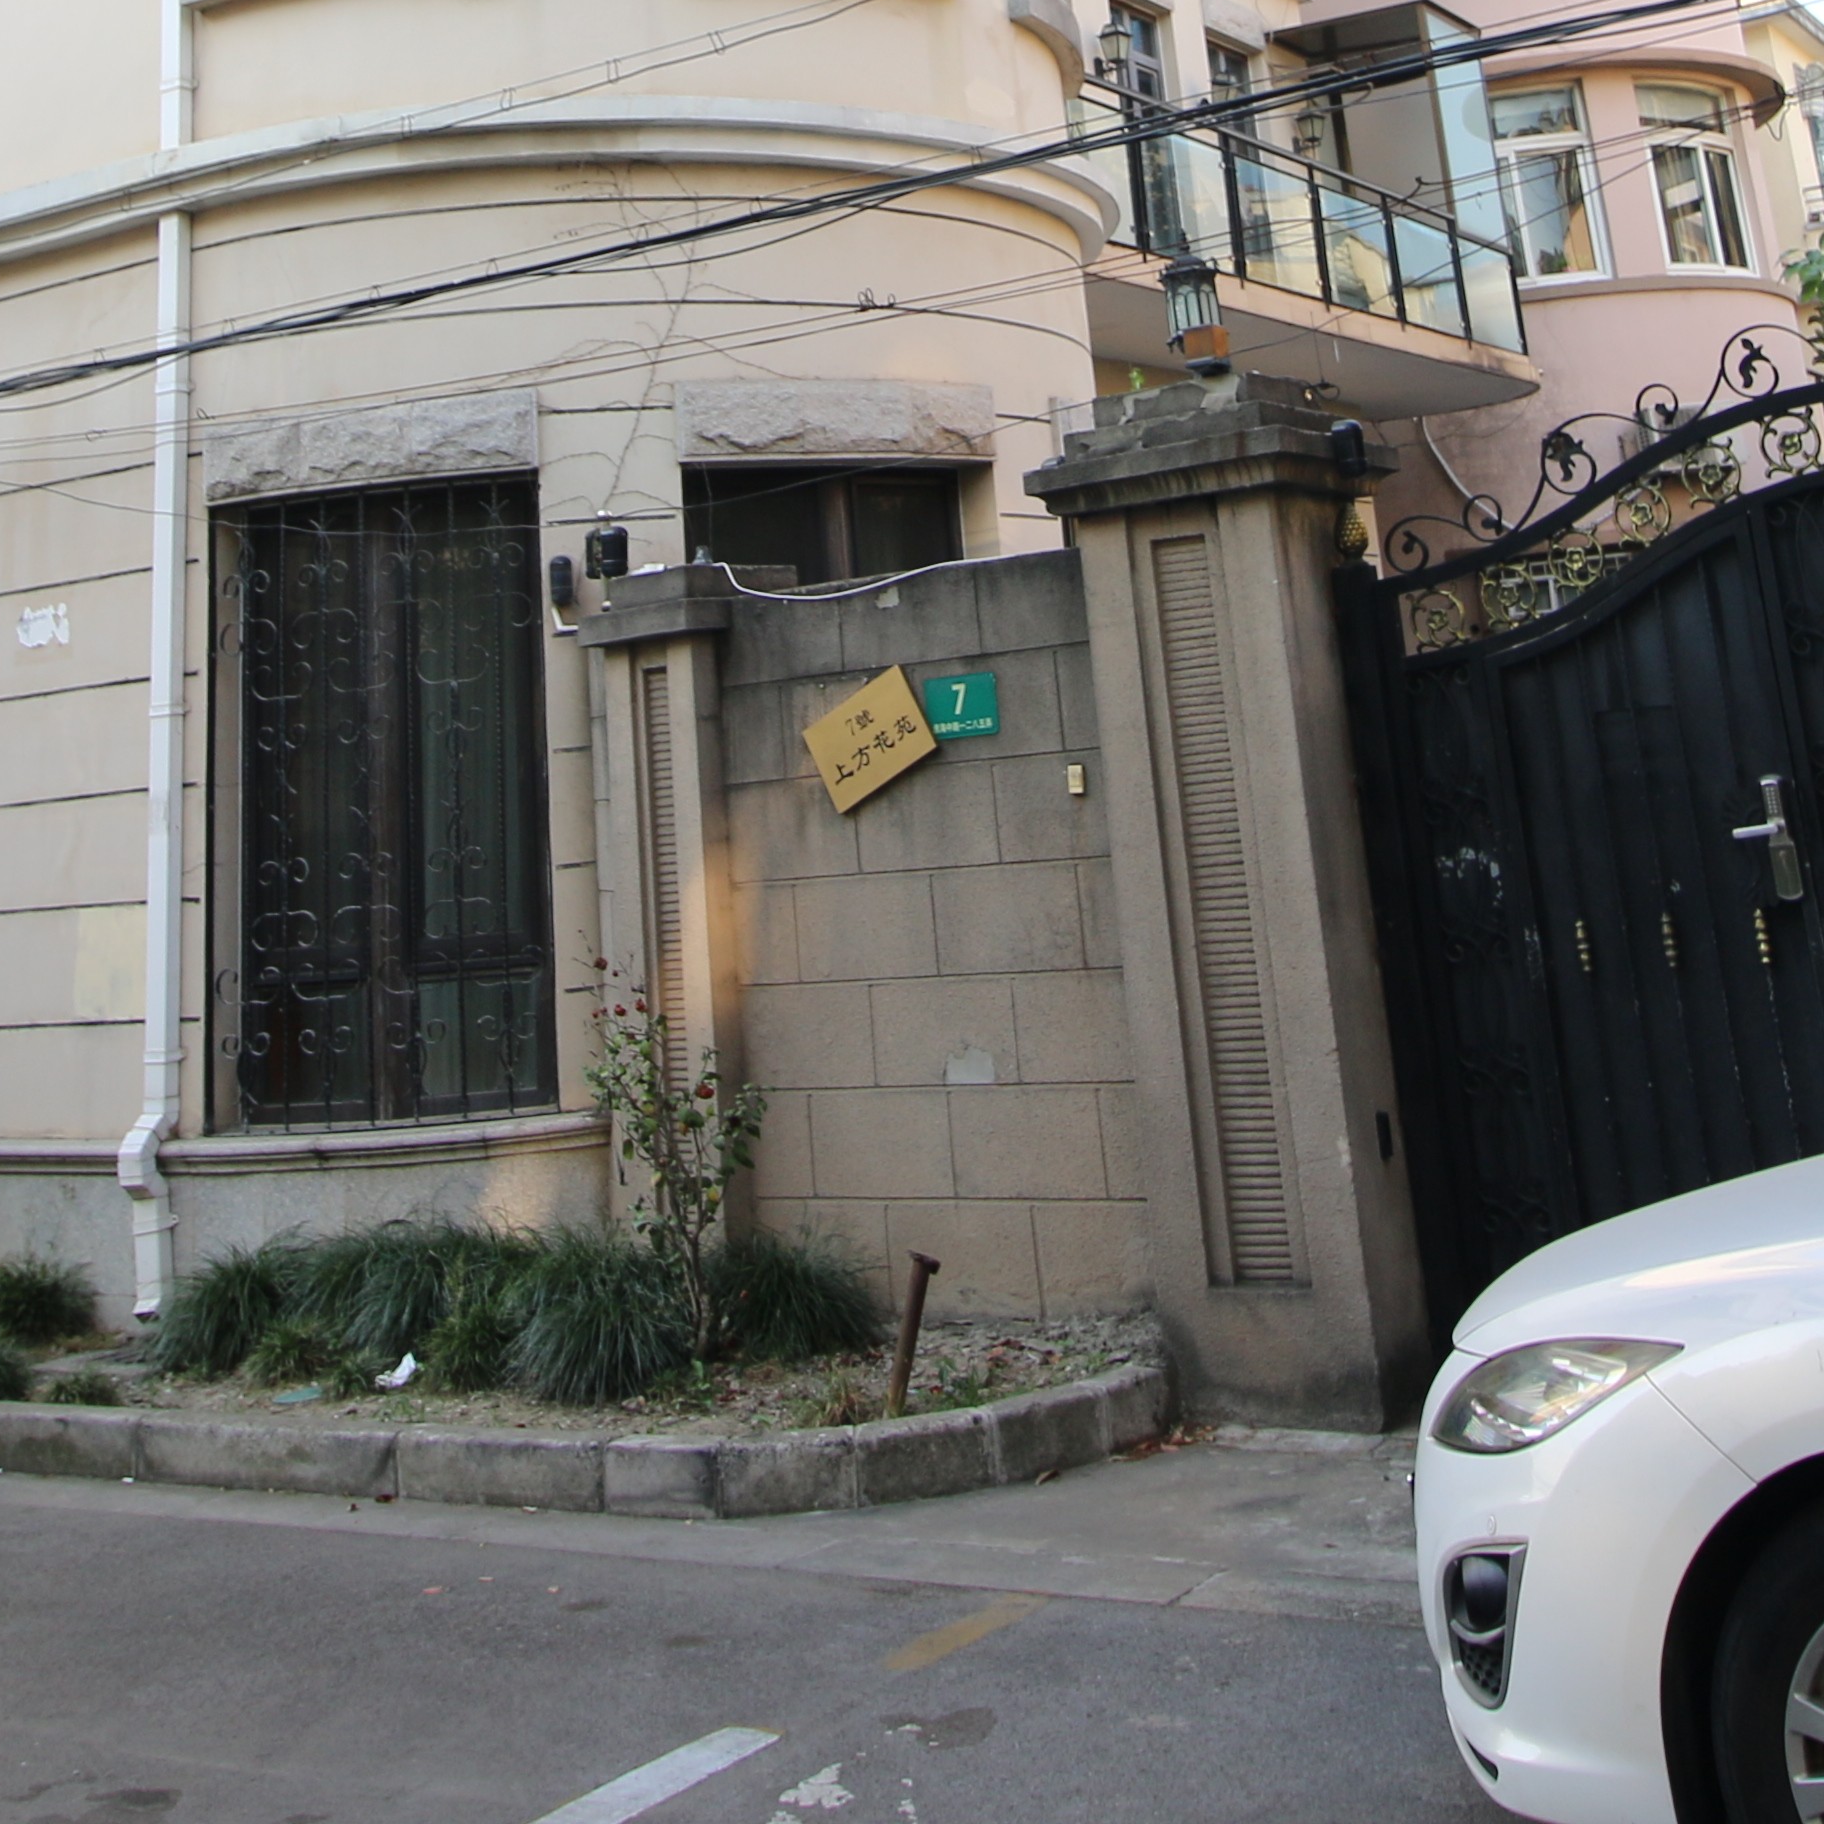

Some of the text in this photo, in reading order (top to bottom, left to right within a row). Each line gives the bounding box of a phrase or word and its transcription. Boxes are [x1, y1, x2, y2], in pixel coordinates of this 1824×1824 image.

[950, 682, 967, 715] 7
[844, 709, 875, 736] 7號
[834, 714, 917, 787] 上方花苑
